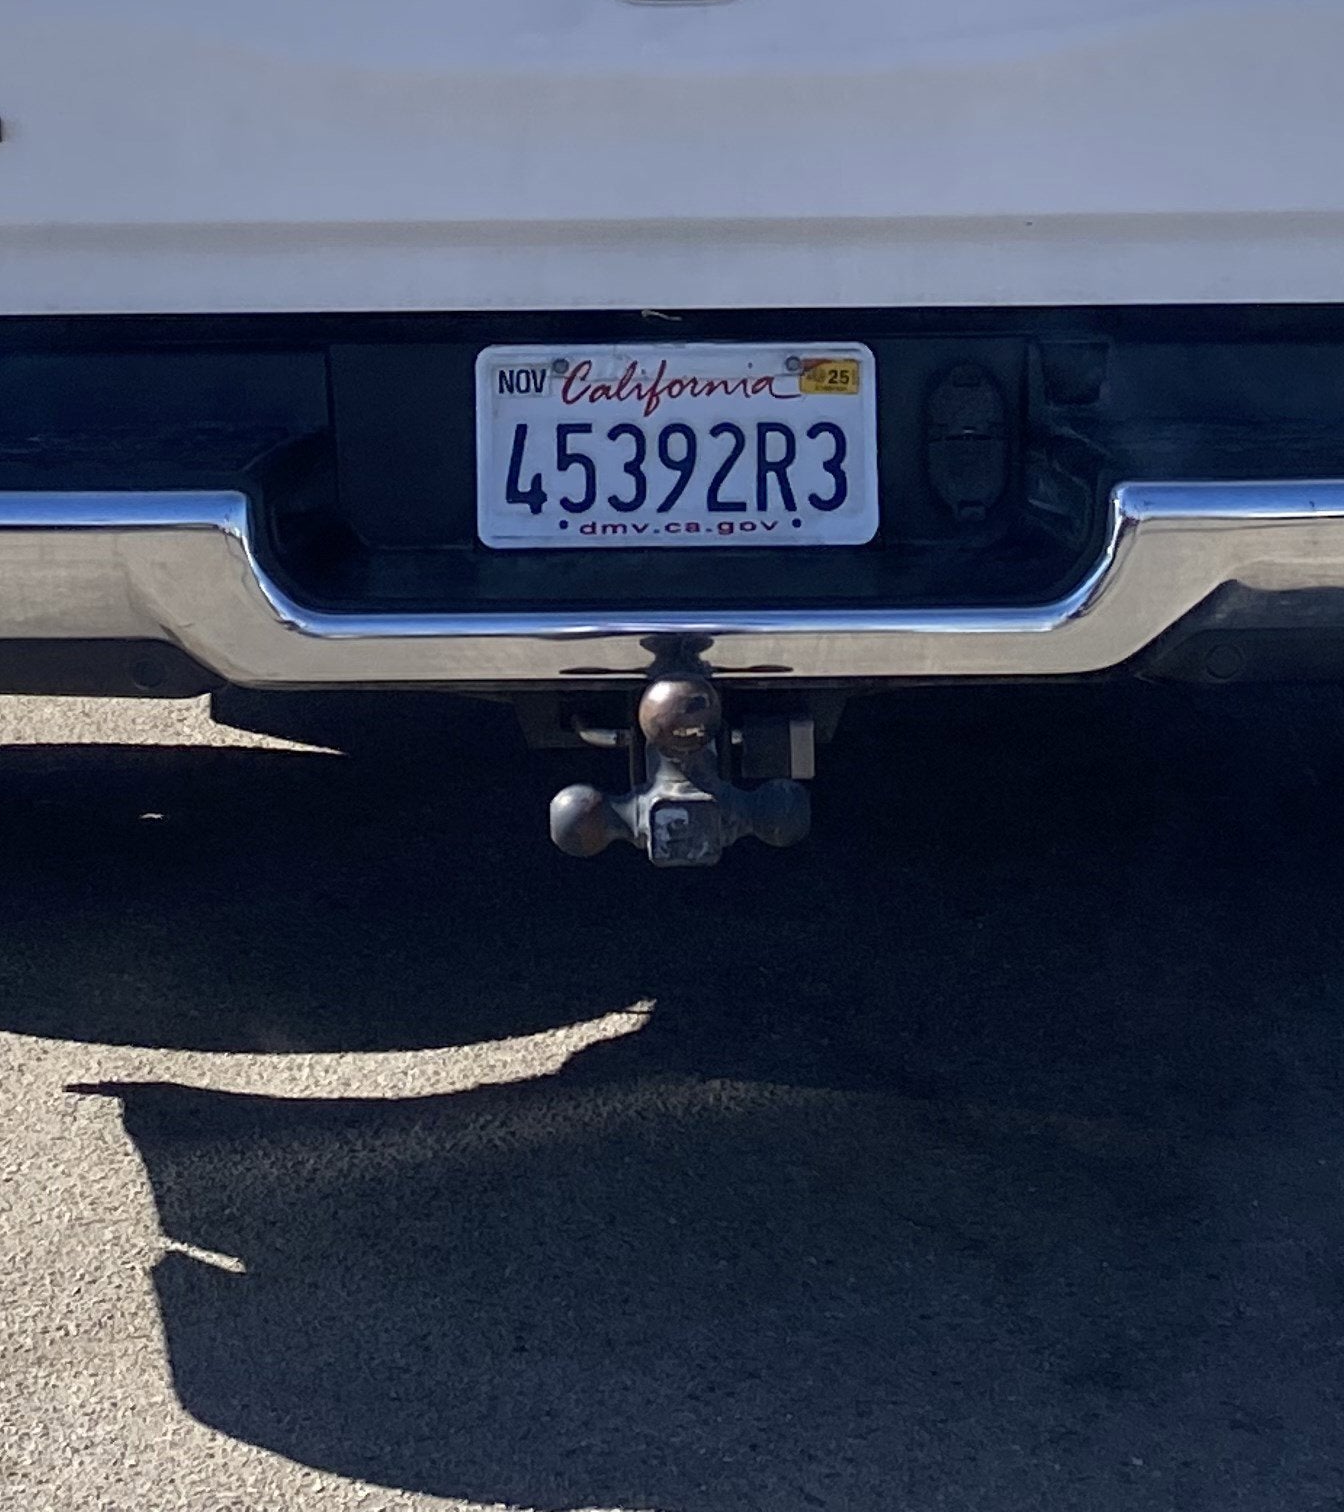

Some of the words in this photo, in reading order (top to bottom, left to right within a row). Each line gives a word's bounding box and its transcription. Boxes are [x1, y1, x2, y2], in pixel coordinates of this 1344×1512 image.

[498, 368, 547, 394] NOV
[560, 359, 803, 418] California
[828, 369, 850, 385] 25
[505, 421, 849, 515] 45392R3
[579, 519, 779, 536] dmv.ca.gov
